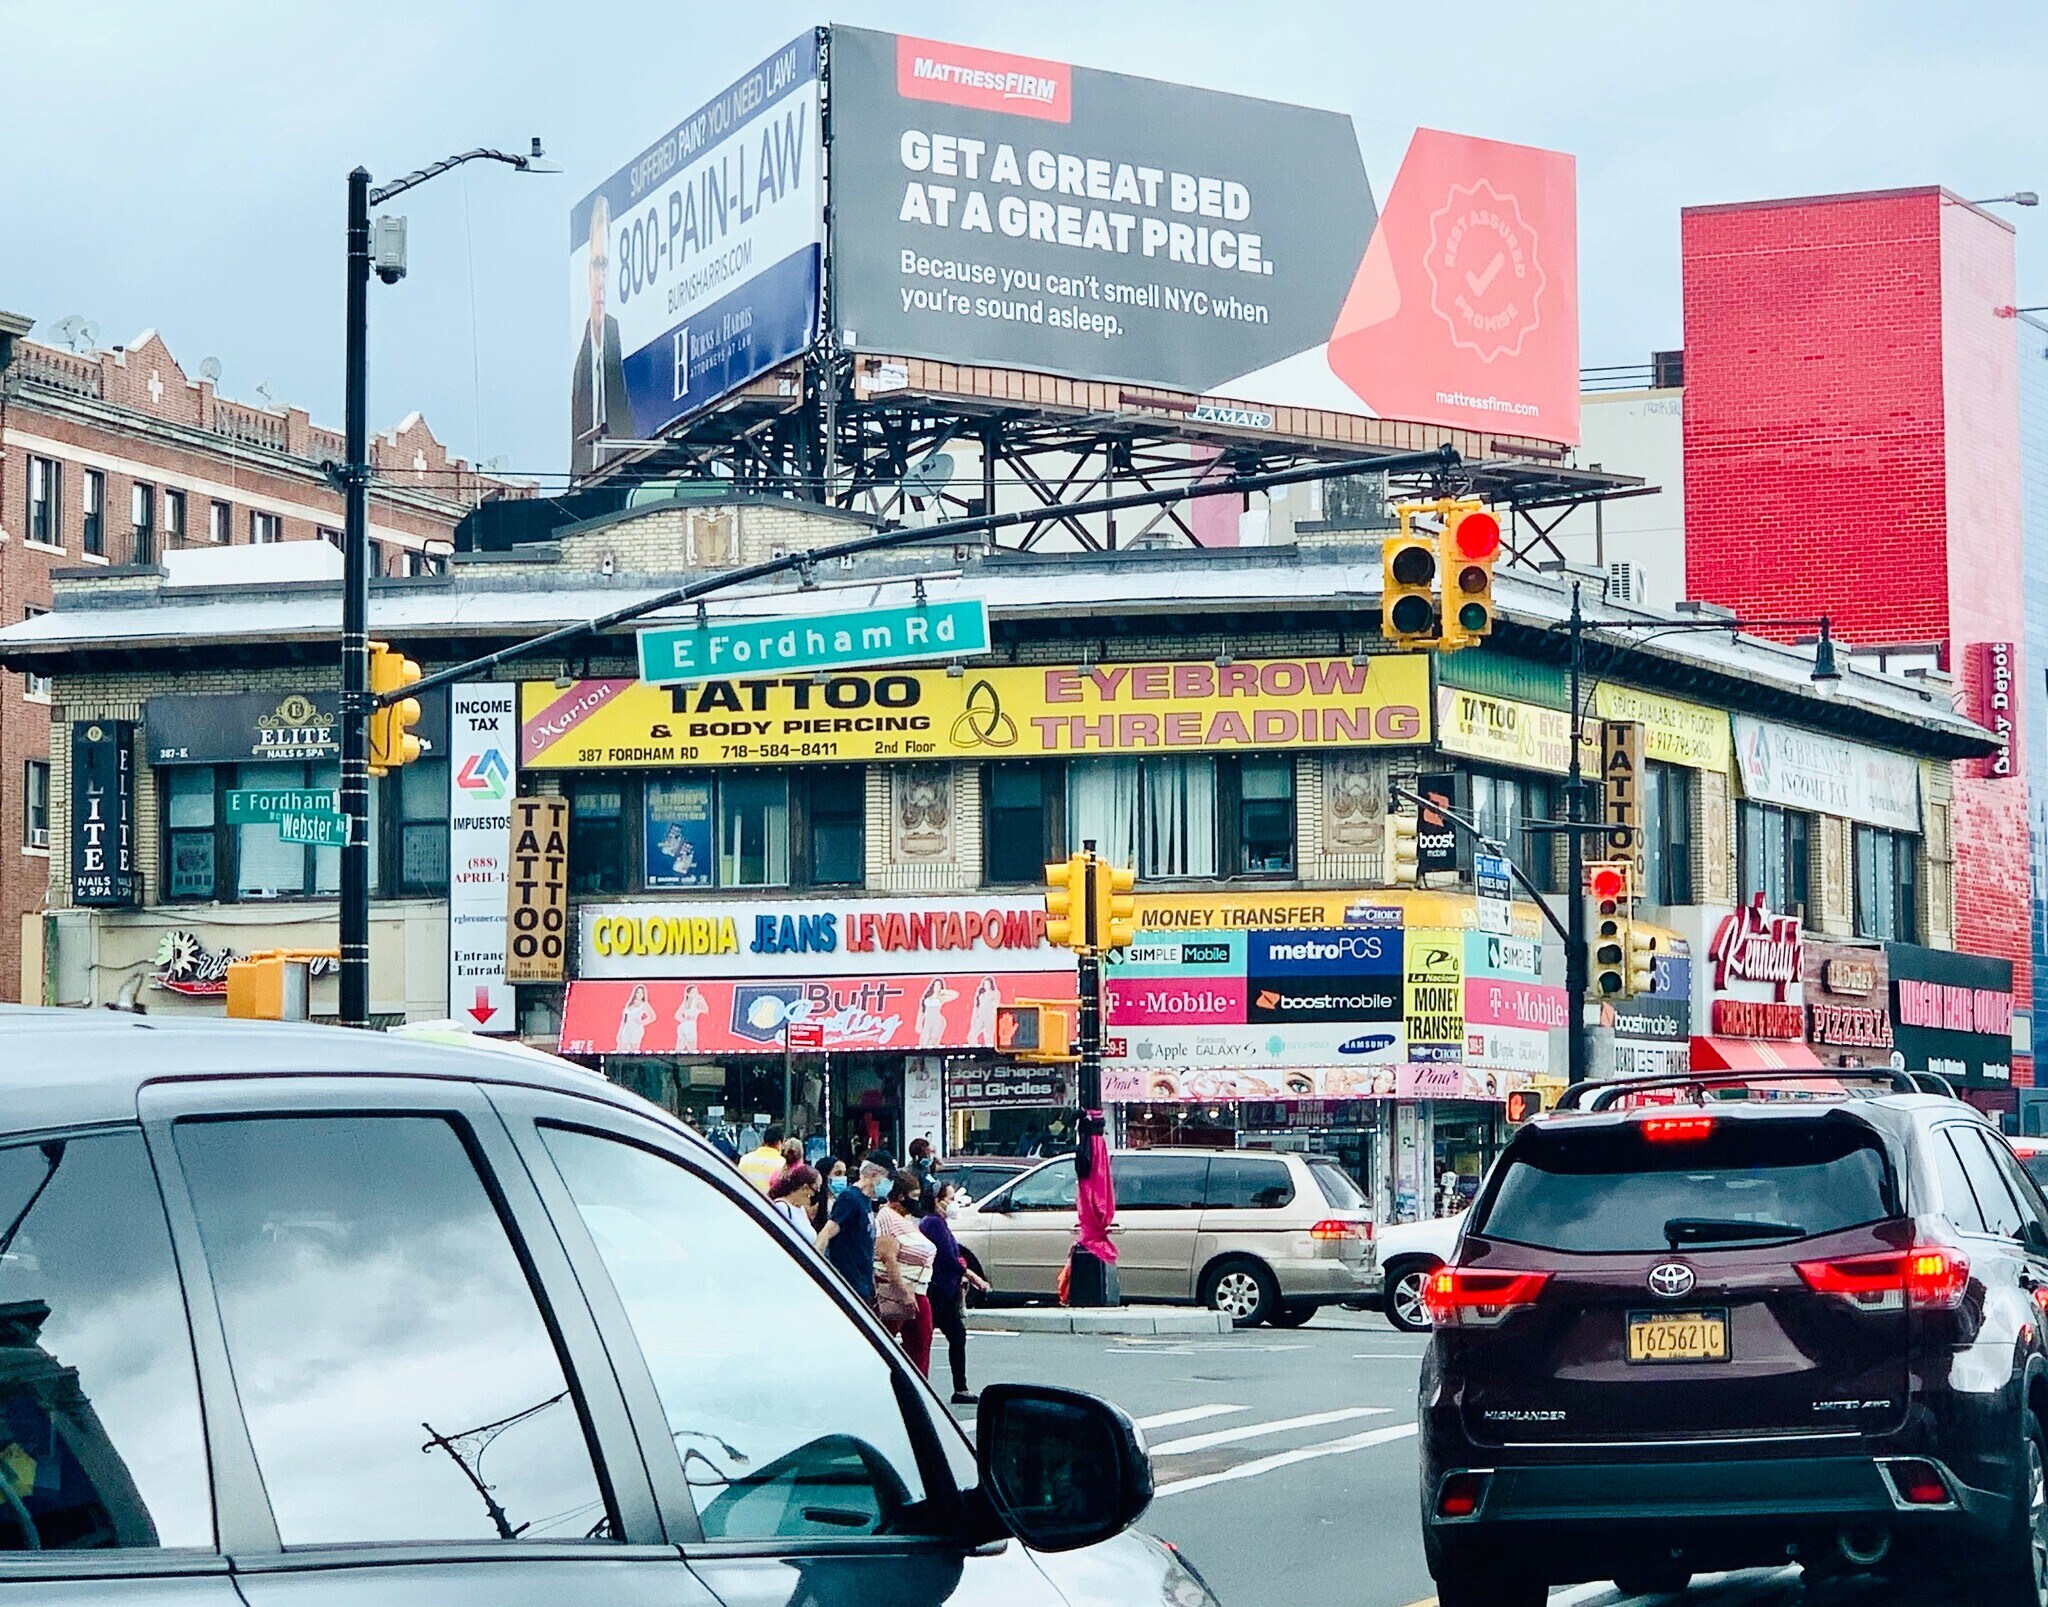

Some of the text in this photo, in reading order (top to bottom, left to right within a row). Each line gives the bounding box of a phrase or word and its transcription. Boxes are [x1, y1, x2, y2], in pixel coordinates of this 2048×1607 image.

[630, 47, 797, 197] SUFFERED PAIN? YOU NEED LAW!
[900, 129, 1251, 222] GET A GREAT BED
[619, 101, 806, 305] 800-PAIN-LAW
[899, 182, 1275, 276] AT A GREAT PRICE.
[1444, 209, 1526, 280] REST ASSURED
[900, 249, 1269, 325] Because you can't smell NYC when
[900, 286, 1124, 340] you're sound asleep.
[1454, 294, 1519, 333] PROMISE
[1193, 405, 1264, 427] LAMAR
[1435, 390, 1540, 417] mattressfirm.com
[673, 613, 956, 668] E Fordham Rd
[1044, 661, 1370, 704] EYEBROW
[1991, 643, 2013, 711] Depot
[455, 700, 512, 714] INCOME
[660, 675, 922, 714] TATTOO
[468, 718, 499, 731] TAX
[531, 682, 612, 750] Marion
[1462, 696, 1516, 730] TATTOO
[260, 727, 331, 746] ELITE
[650, 716, 931, 739] & BODY PIERCING
[1031, 706, 1421, 750] THREADING
[1540, 713, 1602, 746] EYEOW
[266, 749, 295, 759] NAILS
[306, 748, 325, 758] SPA
[578, 739, 936, 763] 387 FORDHAM RD 718-584-8411 2nd Floor
[119, 749, 130, 872] ELITE
[232, 792, 331, 811] E Fordham
[282, 812, 332, 842] Webster
[453, 816, 511, 831] IMPUESTOS
[1419, 830, 1455, 849] boost
[468, 857, 498, 869] (888)
[77, 876, 111, 887] NAILS
[454, 872, 510, 883] APRIL-1
[512, 803, 541, 958] TATTOO
[541, 804, 566, 959] TATTOO
[77, 887, 111, 897] & SPA
[1141, 907, 1325, 927] MONEY TRANSFER
[592, 909, 1050, 957] COLOMBIA JEANS LEVANTAPOMP
[454, 951, 505, 962] Entranc
[1130, 947, 1228, 962] SIMPLE Mobile
[1269, 937, 1382, 960] metroPCS
[1503, 946, 1532, 970] SIMPLE
[1716, 905, 1805, 1002] Kennedy's
[808, 983, 903, 1014] Butt
[1414, 987, 1459, 1012] MONEY
[1943, 985, 1974, 1032] HAIR
[1405, 1015, 1464, 1040] TRANSFER
[1720, 1000, 1757, 1037] CHICKEN
[1812, 1003, 1895, 1048] PIZZERIA
[1154, 1040, 1188, 1060] Apple
[1196, 1044, 1241, 1056] GALAXY
[950, 1065, 1055, 1081] Body Shaper
[985, 1082, 1052, 1096] Girdles
[1288, 1112, 1334, 1126] PHONES
[1636, 1325, 1719, 1352] T625621C
[1484, 1409, 1567, 1422] HIGHLANDER
